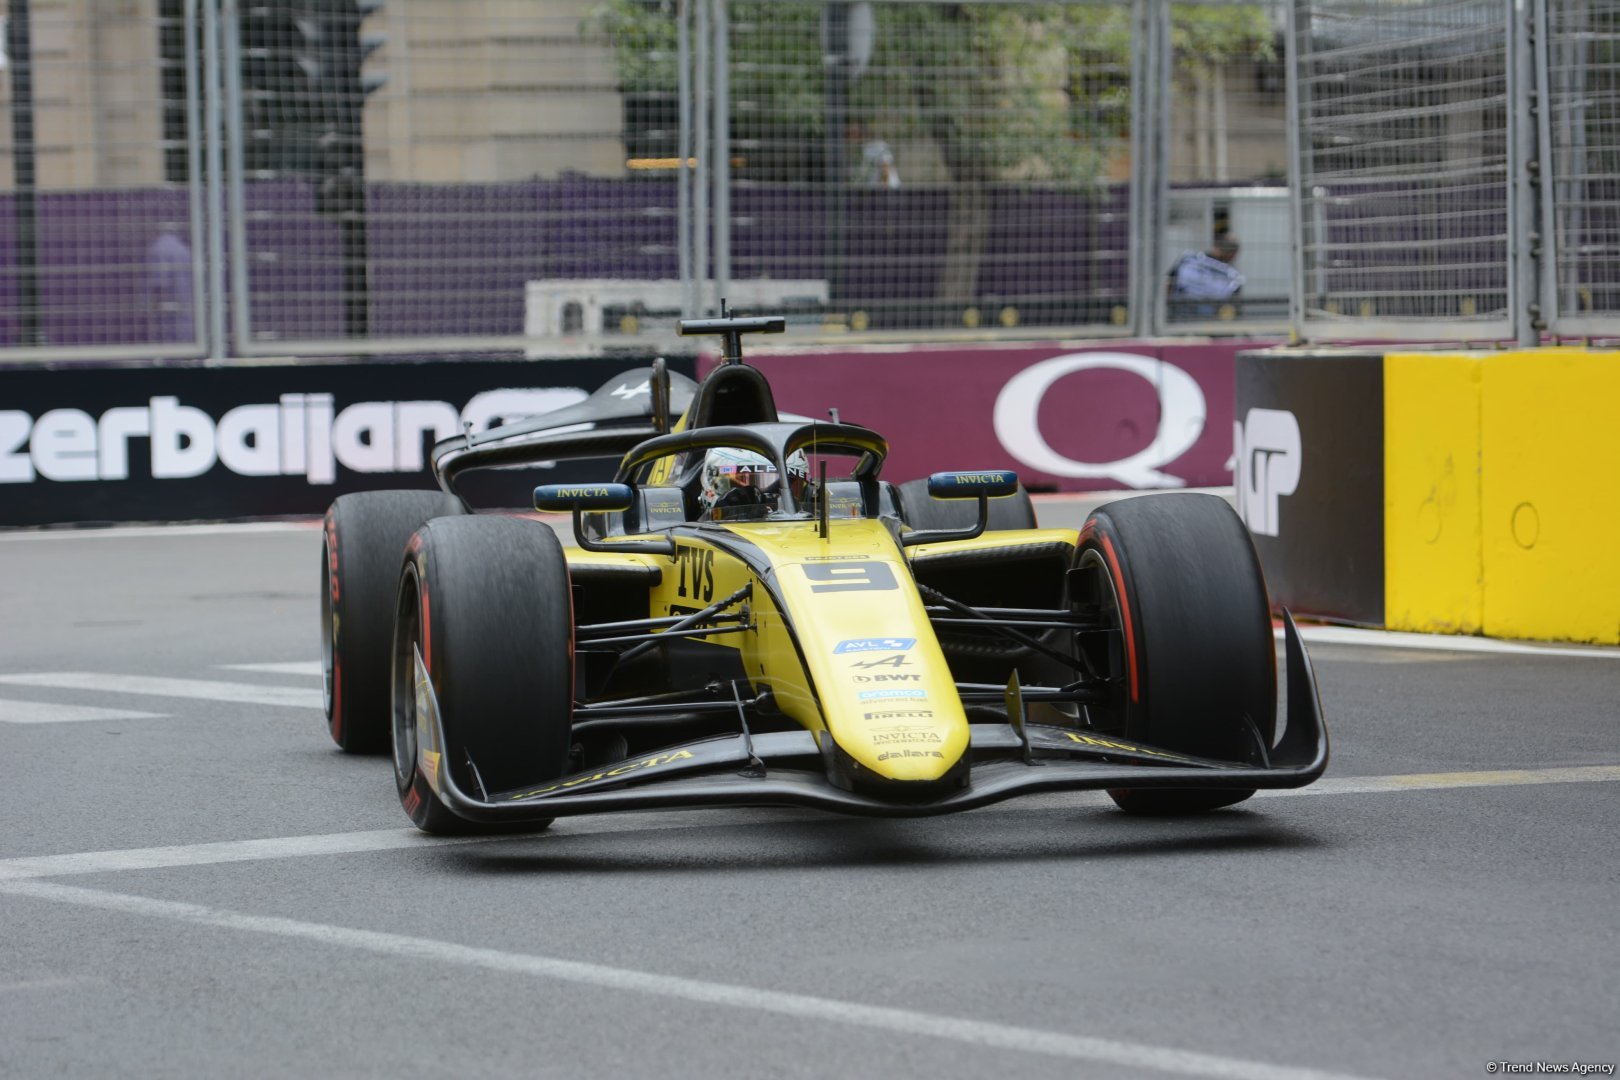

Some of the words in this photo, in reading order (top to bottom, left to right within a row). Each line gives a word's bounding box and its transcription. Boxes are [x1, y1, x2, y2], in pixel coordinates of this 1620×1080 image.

[739, 464, 806, 479] ALPNE
[955, 474, 1005, 485] INVICTA
[556, 487, 609, 498] INVICTA
[650, 506, 682, 514] INVICTA
[676, 544, 714, 603] TVS
[800, 561, 899, 594] 9
[845, 641, 879, 649] AVL
[874, 674, 921, 682] BWT
[861, 689, 922, 699] aramco
[864, 709, 933, 720] PIRELLI
[873, 732, 940, 741] INVICTA
[877, 749, 945, 761] dallara
